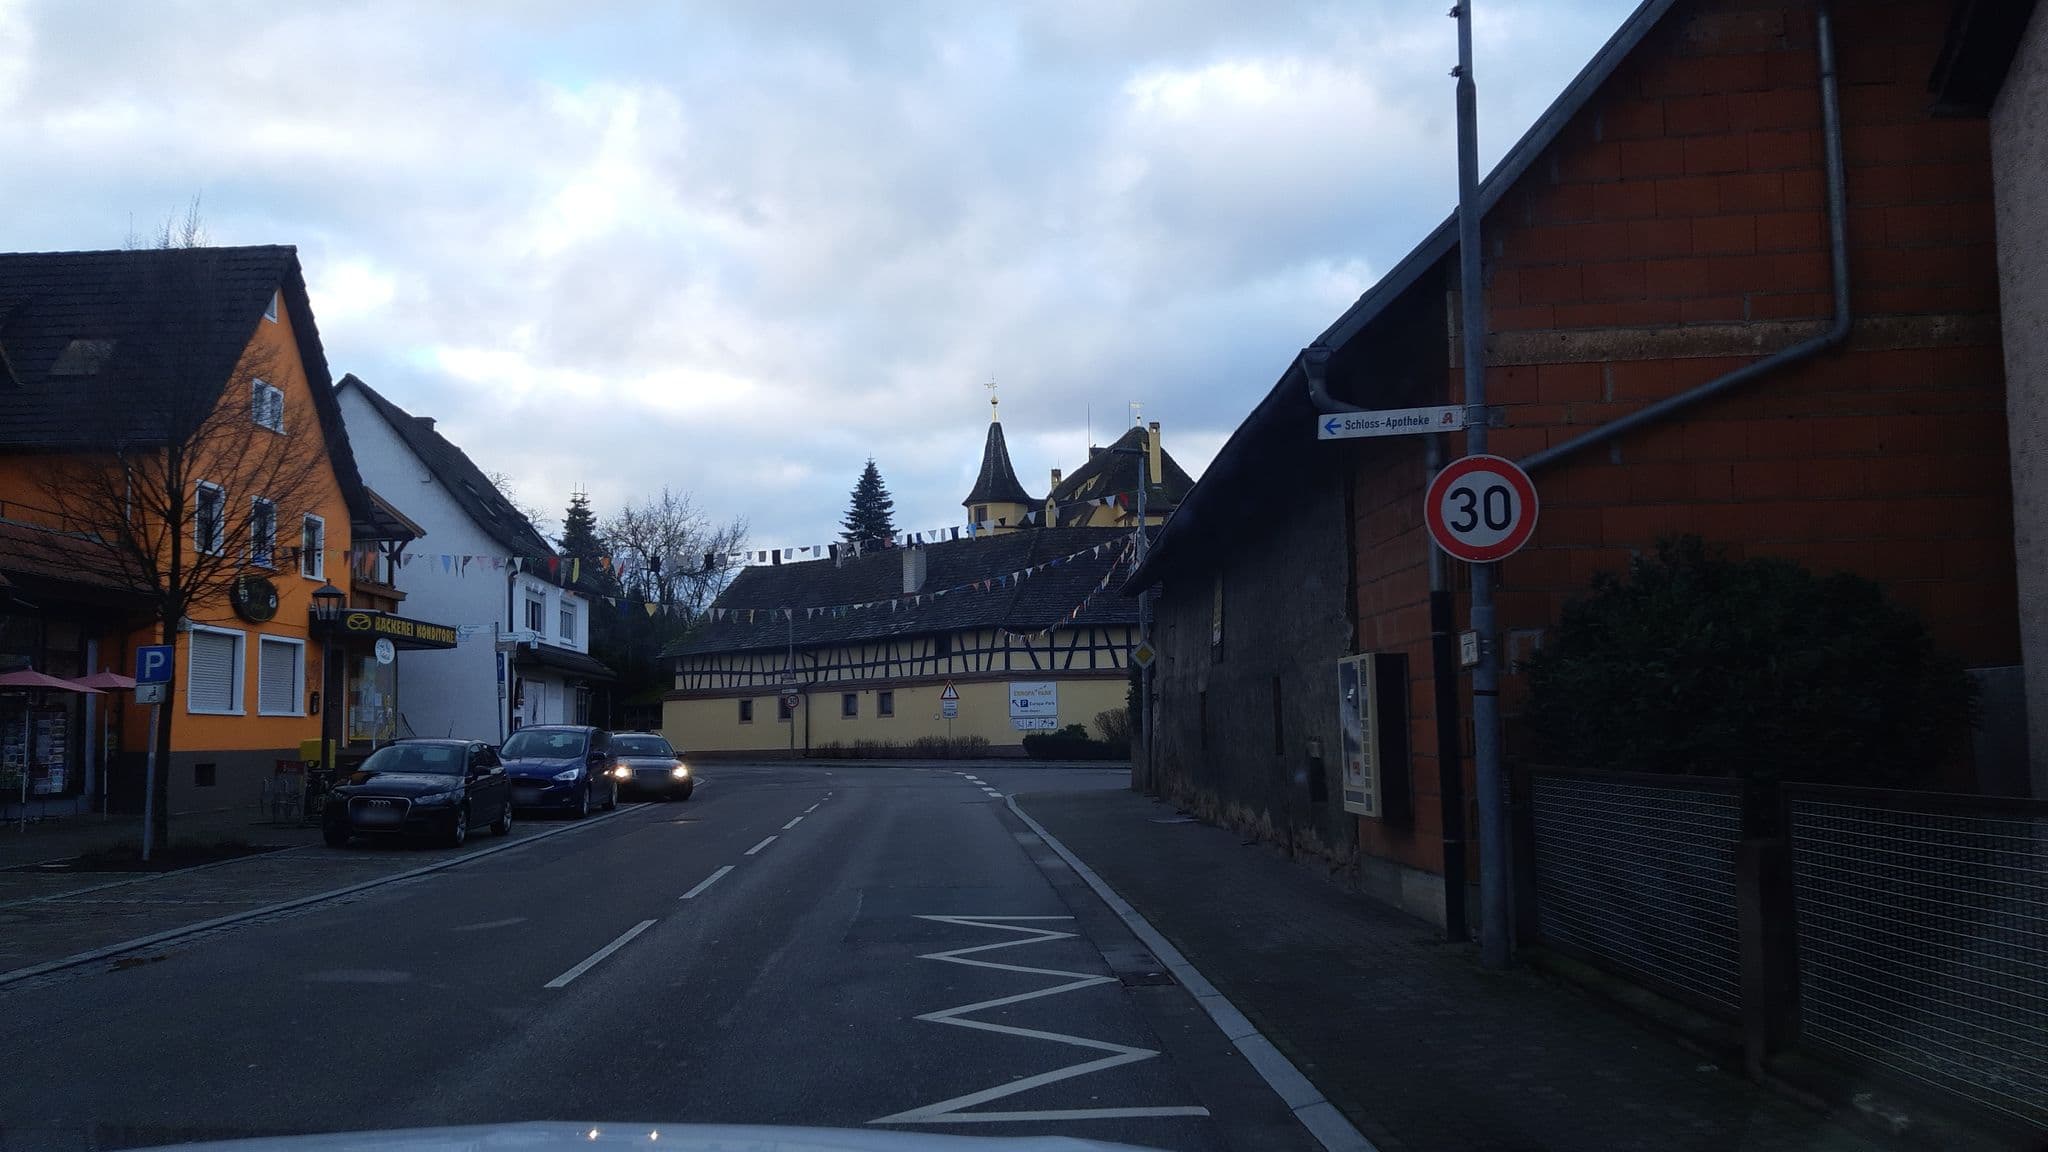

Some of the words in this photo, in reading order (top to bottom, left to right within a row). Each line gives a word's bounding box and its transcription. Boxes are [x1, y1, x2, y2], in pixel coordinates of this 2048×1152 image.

[1344, 415, 1430, 431] Schloss-Apotheke
[1449, 485, 1513, 533] 30
[145, 651, 165, 679] P
